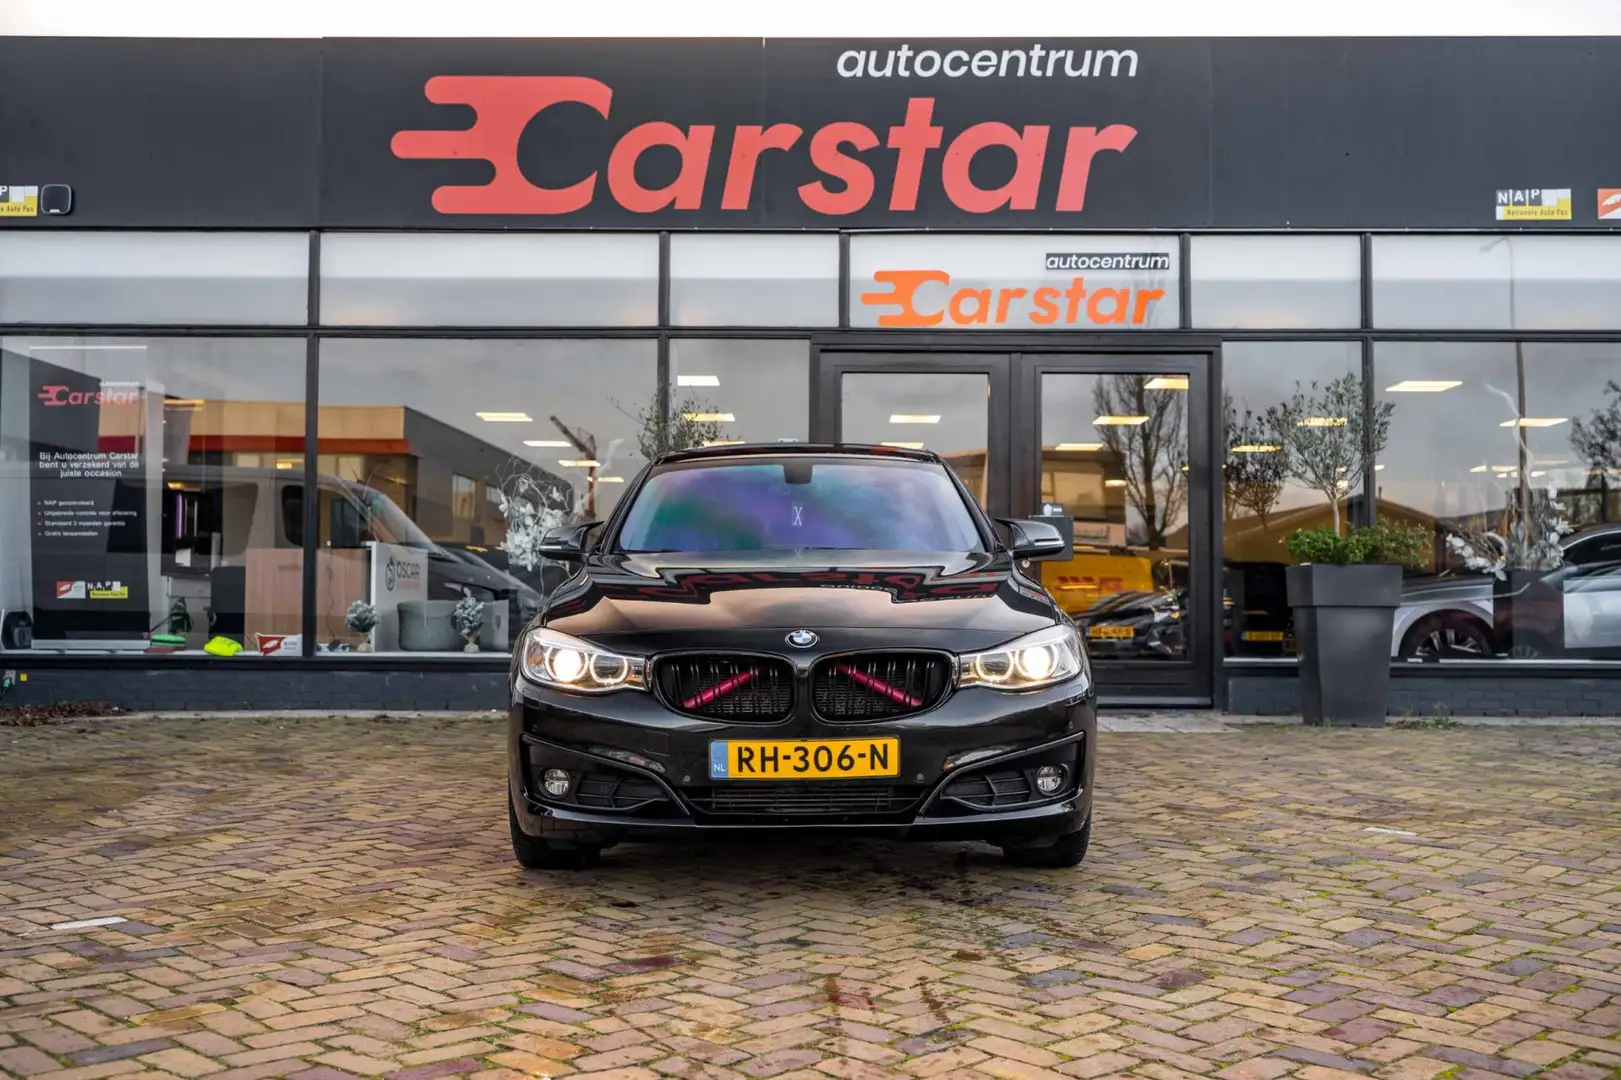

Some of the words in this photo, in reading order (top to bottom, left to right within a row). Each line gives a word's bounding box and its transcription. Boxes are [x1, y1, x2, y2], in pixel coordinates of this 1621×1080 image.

[836, 43, 1139, 79] autocentrum
[390, 75, 1138, 215] Carstar
[1046, 253, 1170, 269] autocentrum
[860, 269, 1166, 327] Carstar
[38, 385, 139, 406] Carstar
[39, 452, 51, 461] Bij
[53, 452, 107, 460] Autocentrum
[109, 452, 139, 460] Carstar
[39, 461, 59, 469] bent
[69, 461, 110, 469] verzekerd
[129, 460, 140, 468] de
[60, 470, 82, 478] juiste
[713, 763, 727, 772] NL
[736, 743, 889, 773] RH-306-N
